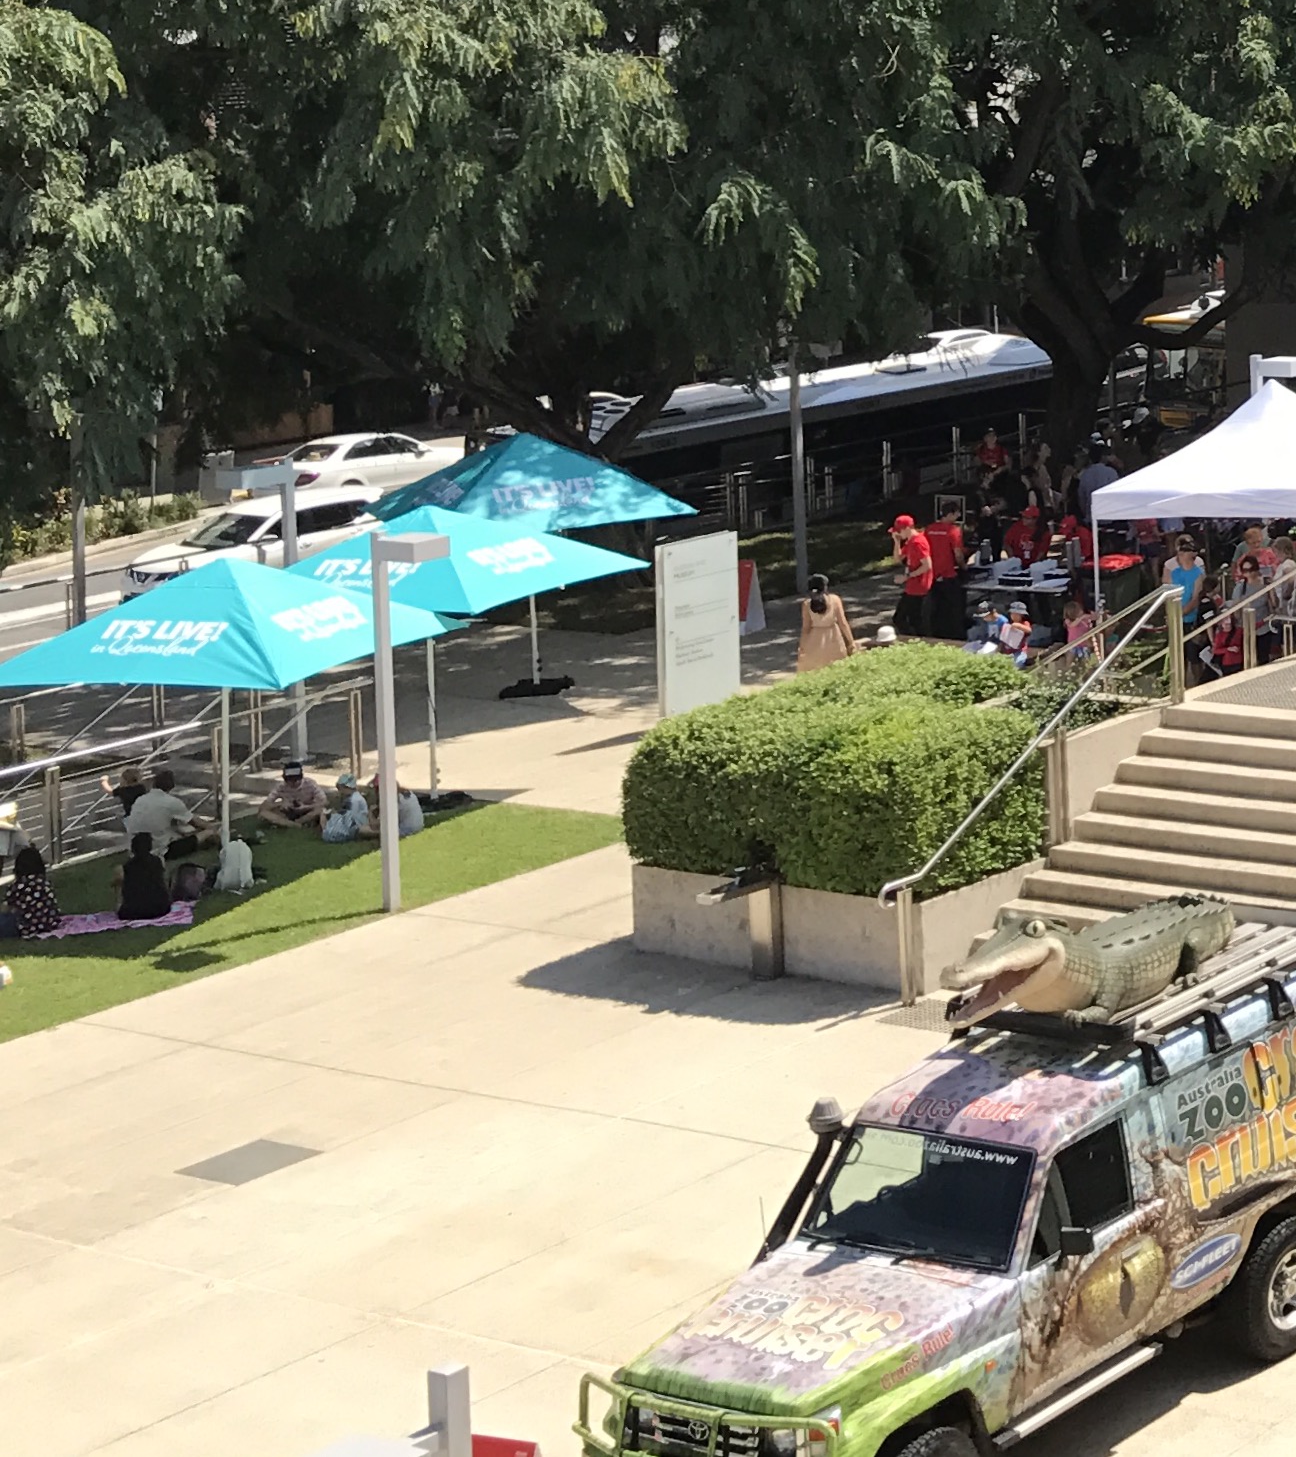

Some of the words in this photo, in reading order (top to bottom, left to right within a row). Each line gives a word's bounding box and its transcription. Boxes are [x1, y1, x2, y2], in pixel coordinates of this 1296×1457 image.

[313, 558, 363, 576] IT'S
[100, 619, 150, 640] IT'S
[151, 620, 230, 642] LIVE!
[107, 634, 207, 657] Queensland
[1176, 1065, 1243, 1111] Australia
[889, 1091, 962, 1119] Crocs
[961, 1096, 1039, 1123] Rule!
